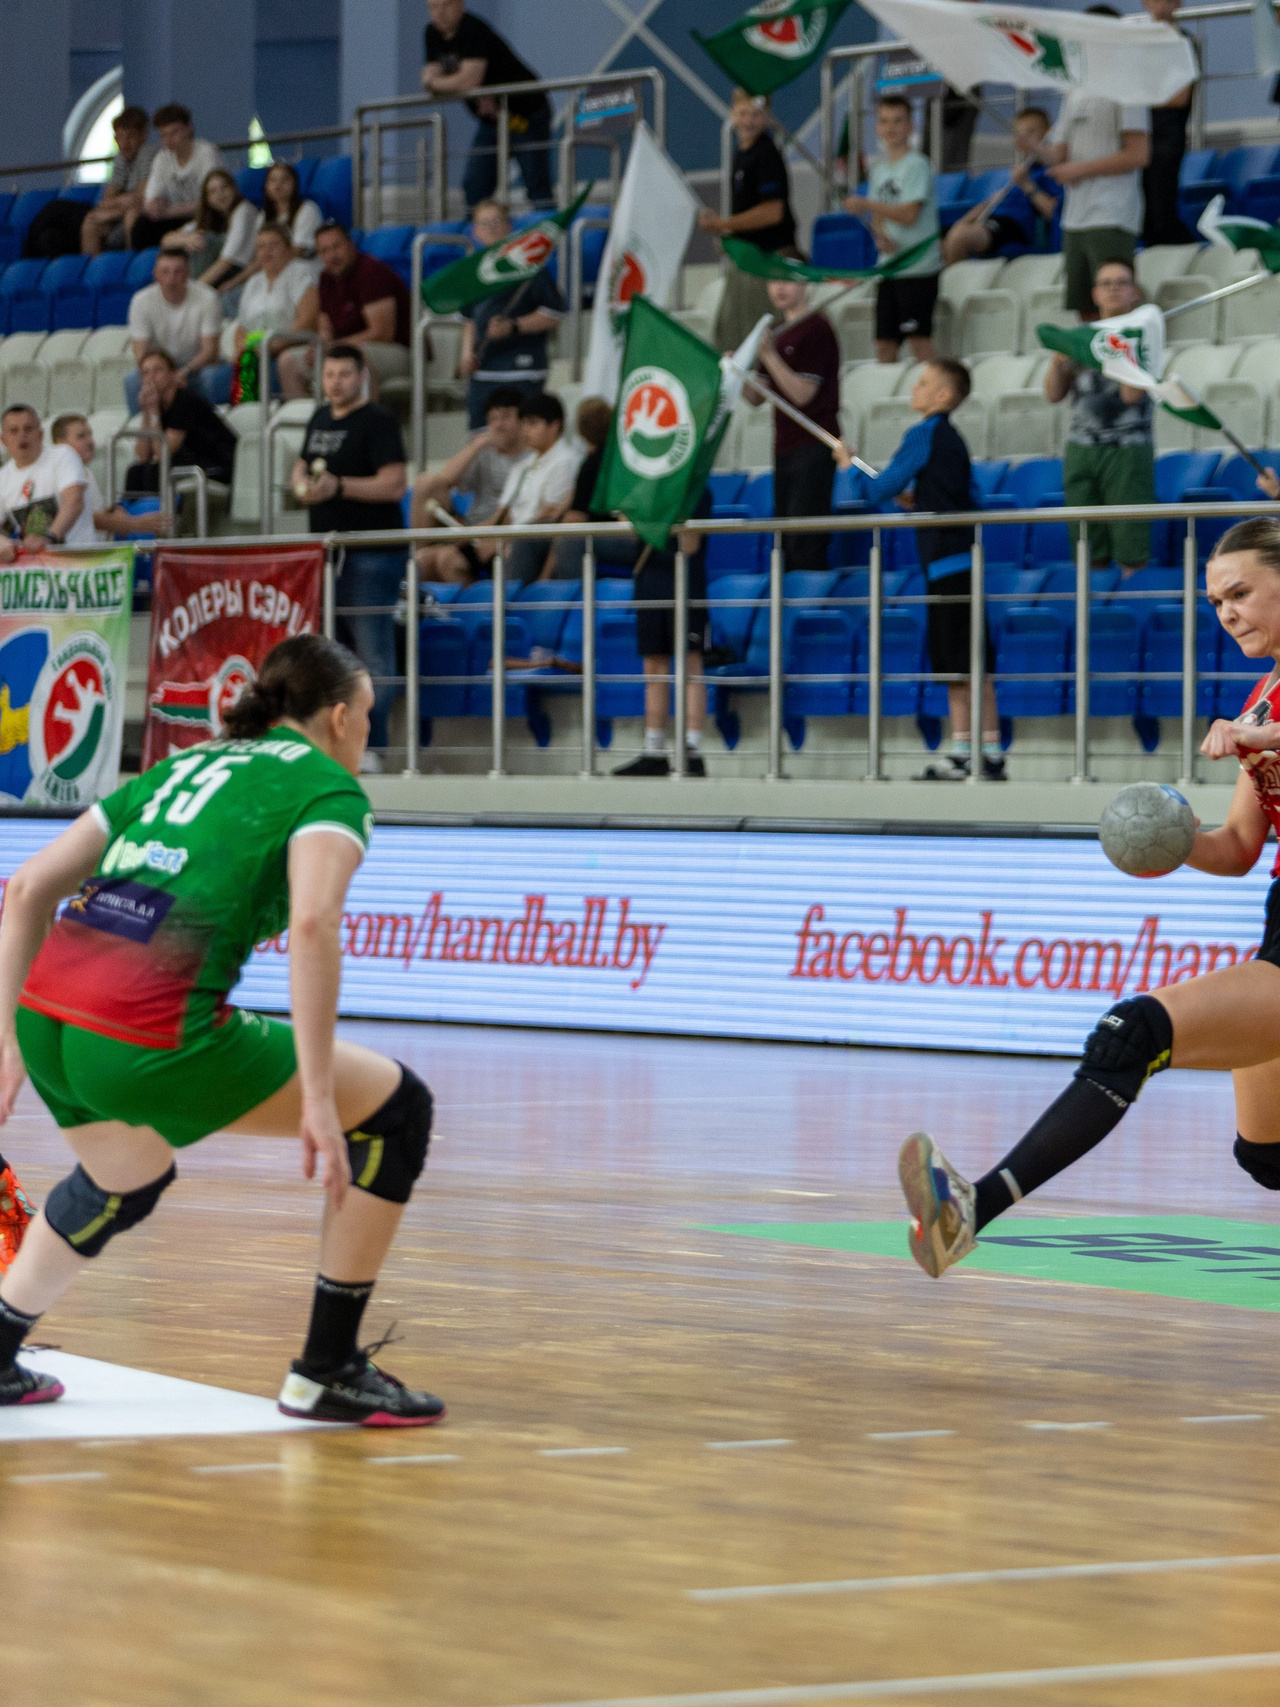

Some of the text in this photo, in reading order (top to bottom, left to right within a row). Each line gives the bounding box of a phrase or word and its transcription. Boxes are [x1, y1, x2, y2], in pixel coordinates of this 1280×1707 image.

[0, 567, 123, 611] ОМЕЛЬЧАНЕ
[158, 578, 244, 660] КОЛЕРЫ
[248, 579, 314, 637] СЭРЦ
[139, 753, 254, 826] 15
